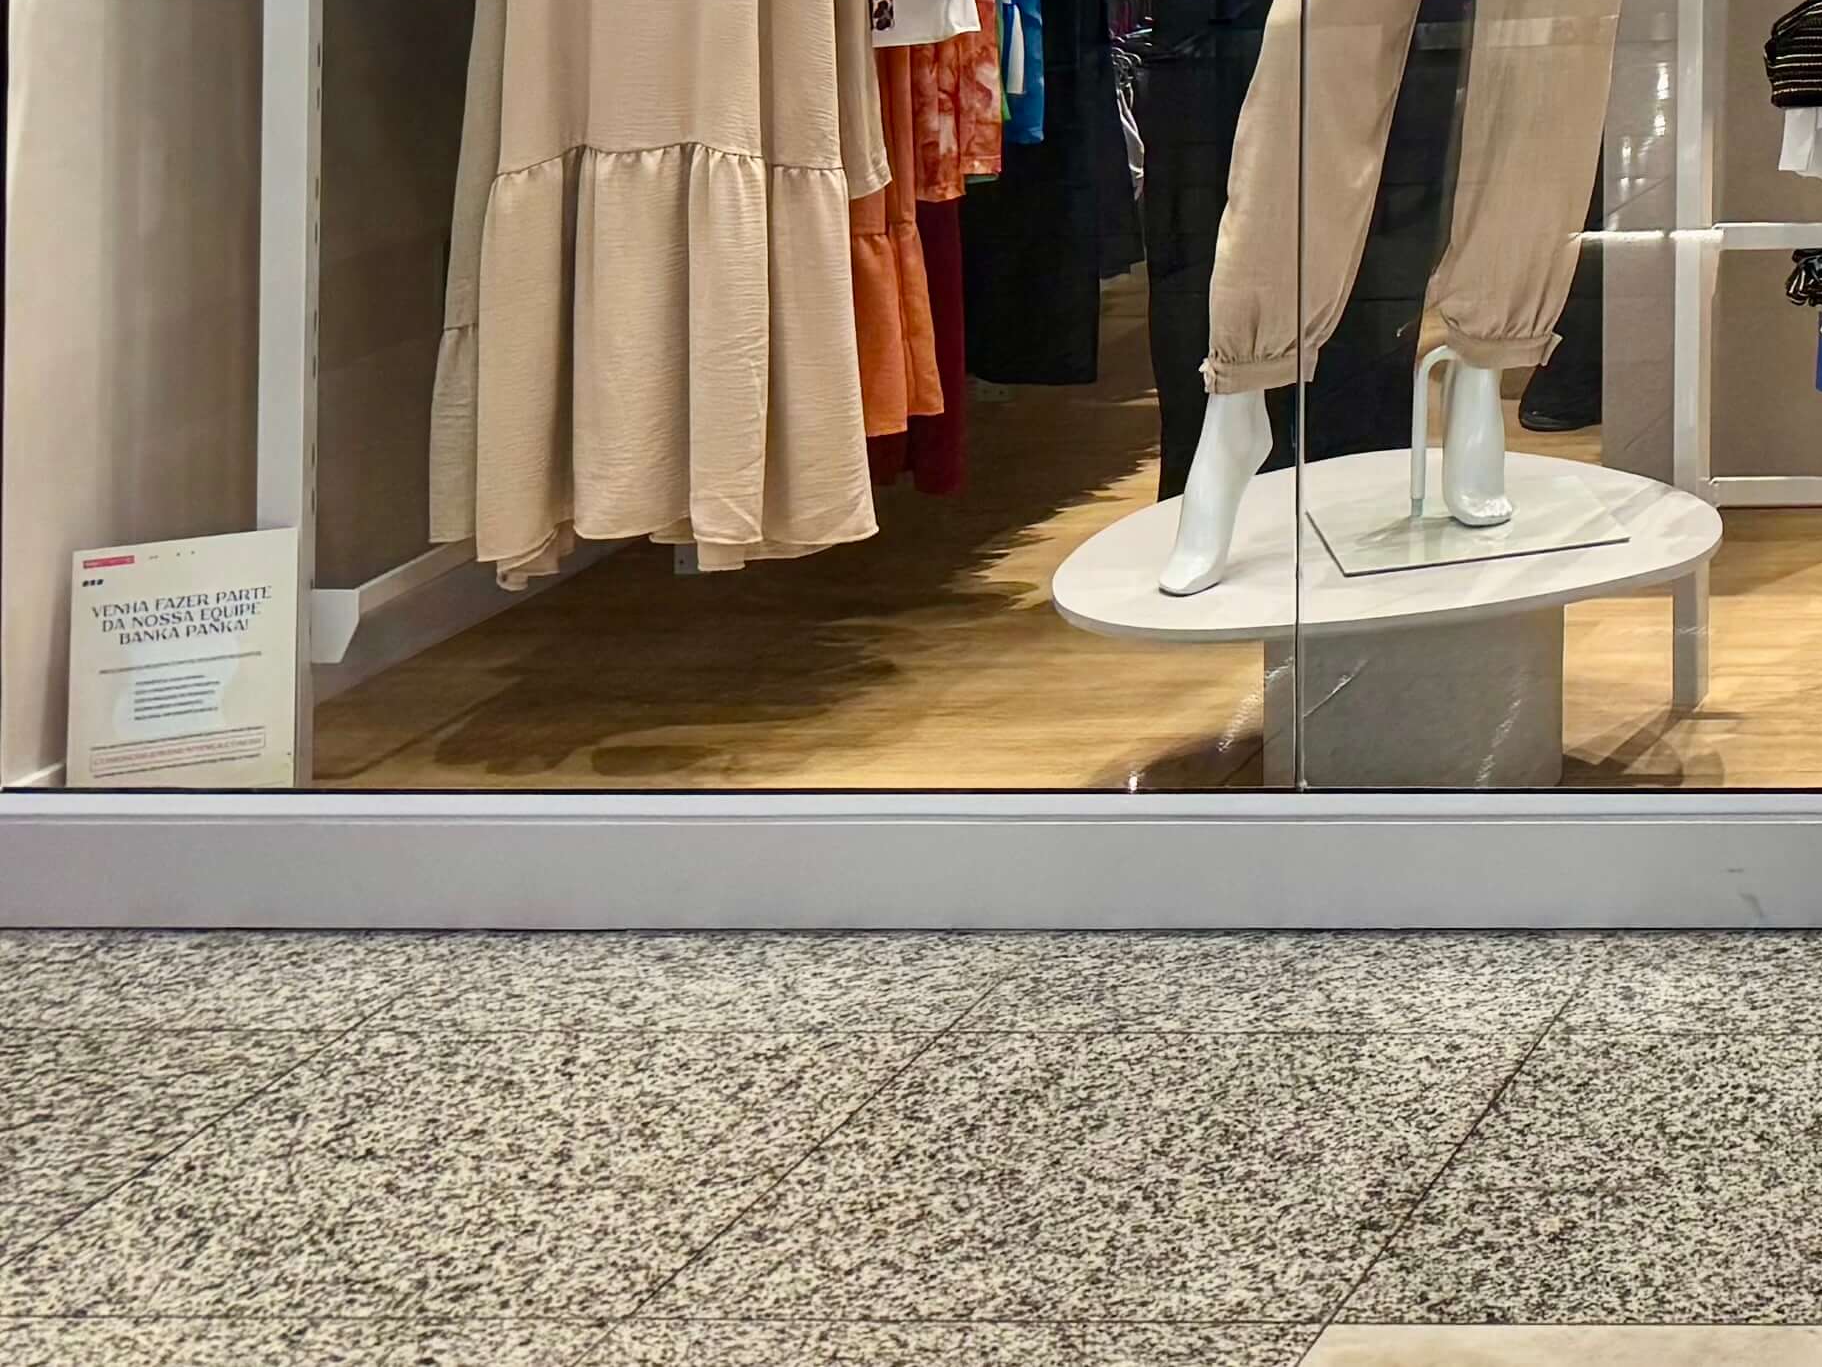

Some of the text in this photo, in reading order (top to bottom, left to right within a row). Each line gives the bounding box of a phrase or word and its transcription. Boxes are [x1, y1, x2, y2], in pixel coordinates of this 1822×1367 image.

[91, 585, 272, 618] VENHA FAZER PARTE
[102, 602, 262, 632] DA NOSSA EQUIPE
[119, 627, 180, 645] BANKA
